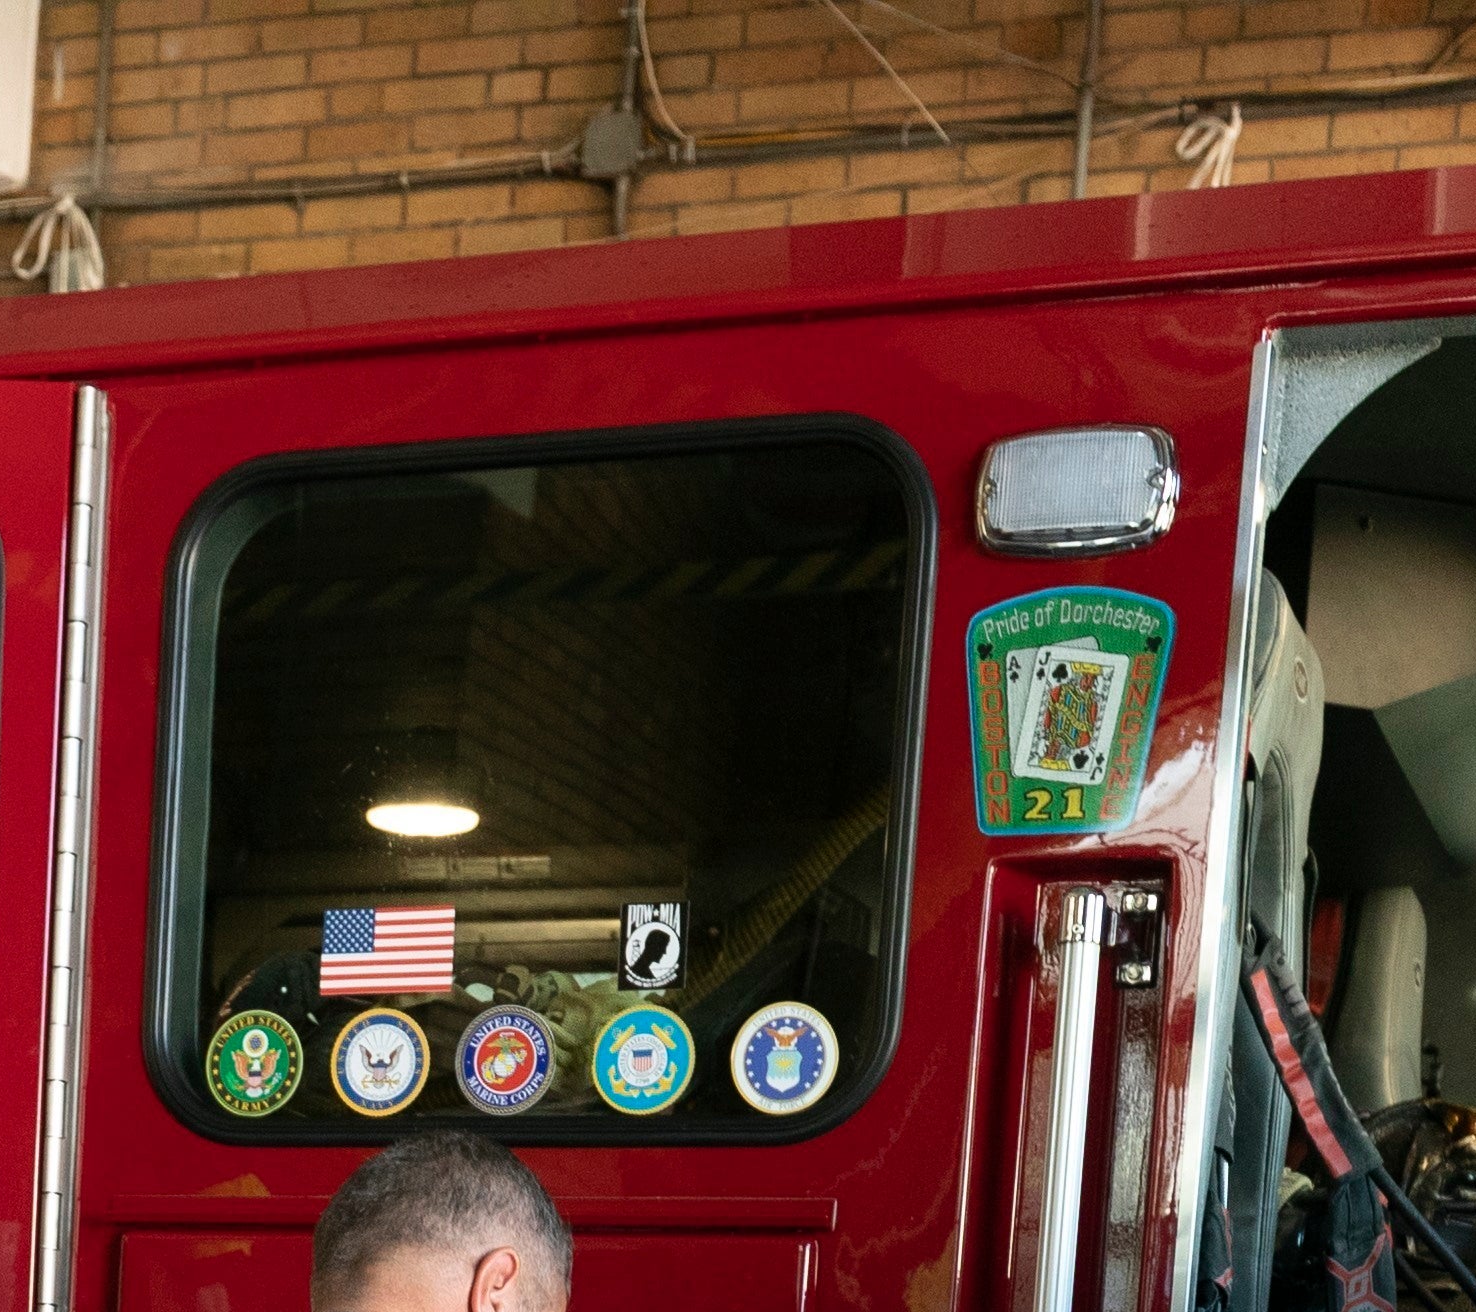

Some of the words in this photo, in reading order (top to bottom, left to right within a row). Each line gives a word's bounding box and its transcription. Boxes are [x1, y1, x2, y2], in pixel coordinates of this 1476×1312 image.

[981, 613, 1030, 642] Pride
[1033, 601, 1057, 628] of
[1059, 597, 1162, 637] Dorchester
[978, 661, 1011, 824] BOSTON
[1097, 653, 1155, 820] ENGINE
[1023, 786, 1088, 821] 21
[627, 904, 654, 938] POW
[660, 903, 680, 937] MIA
[216, 1016, 255, 1047] UNITED
[258, 1016, 293, 1047] STATES
[751, 1006, 788, 1029] UNITED
[790, 1006, 823, 1028] STATES
[469, 1016, 511, 1049] UNITED
[513, 1017, 546, 1056] STATES
[231, 1099, 270, 1112] ARMY
[466, 1075, 509, 1106] MARINE
[511, 1071, 545, 1104] CORPS
